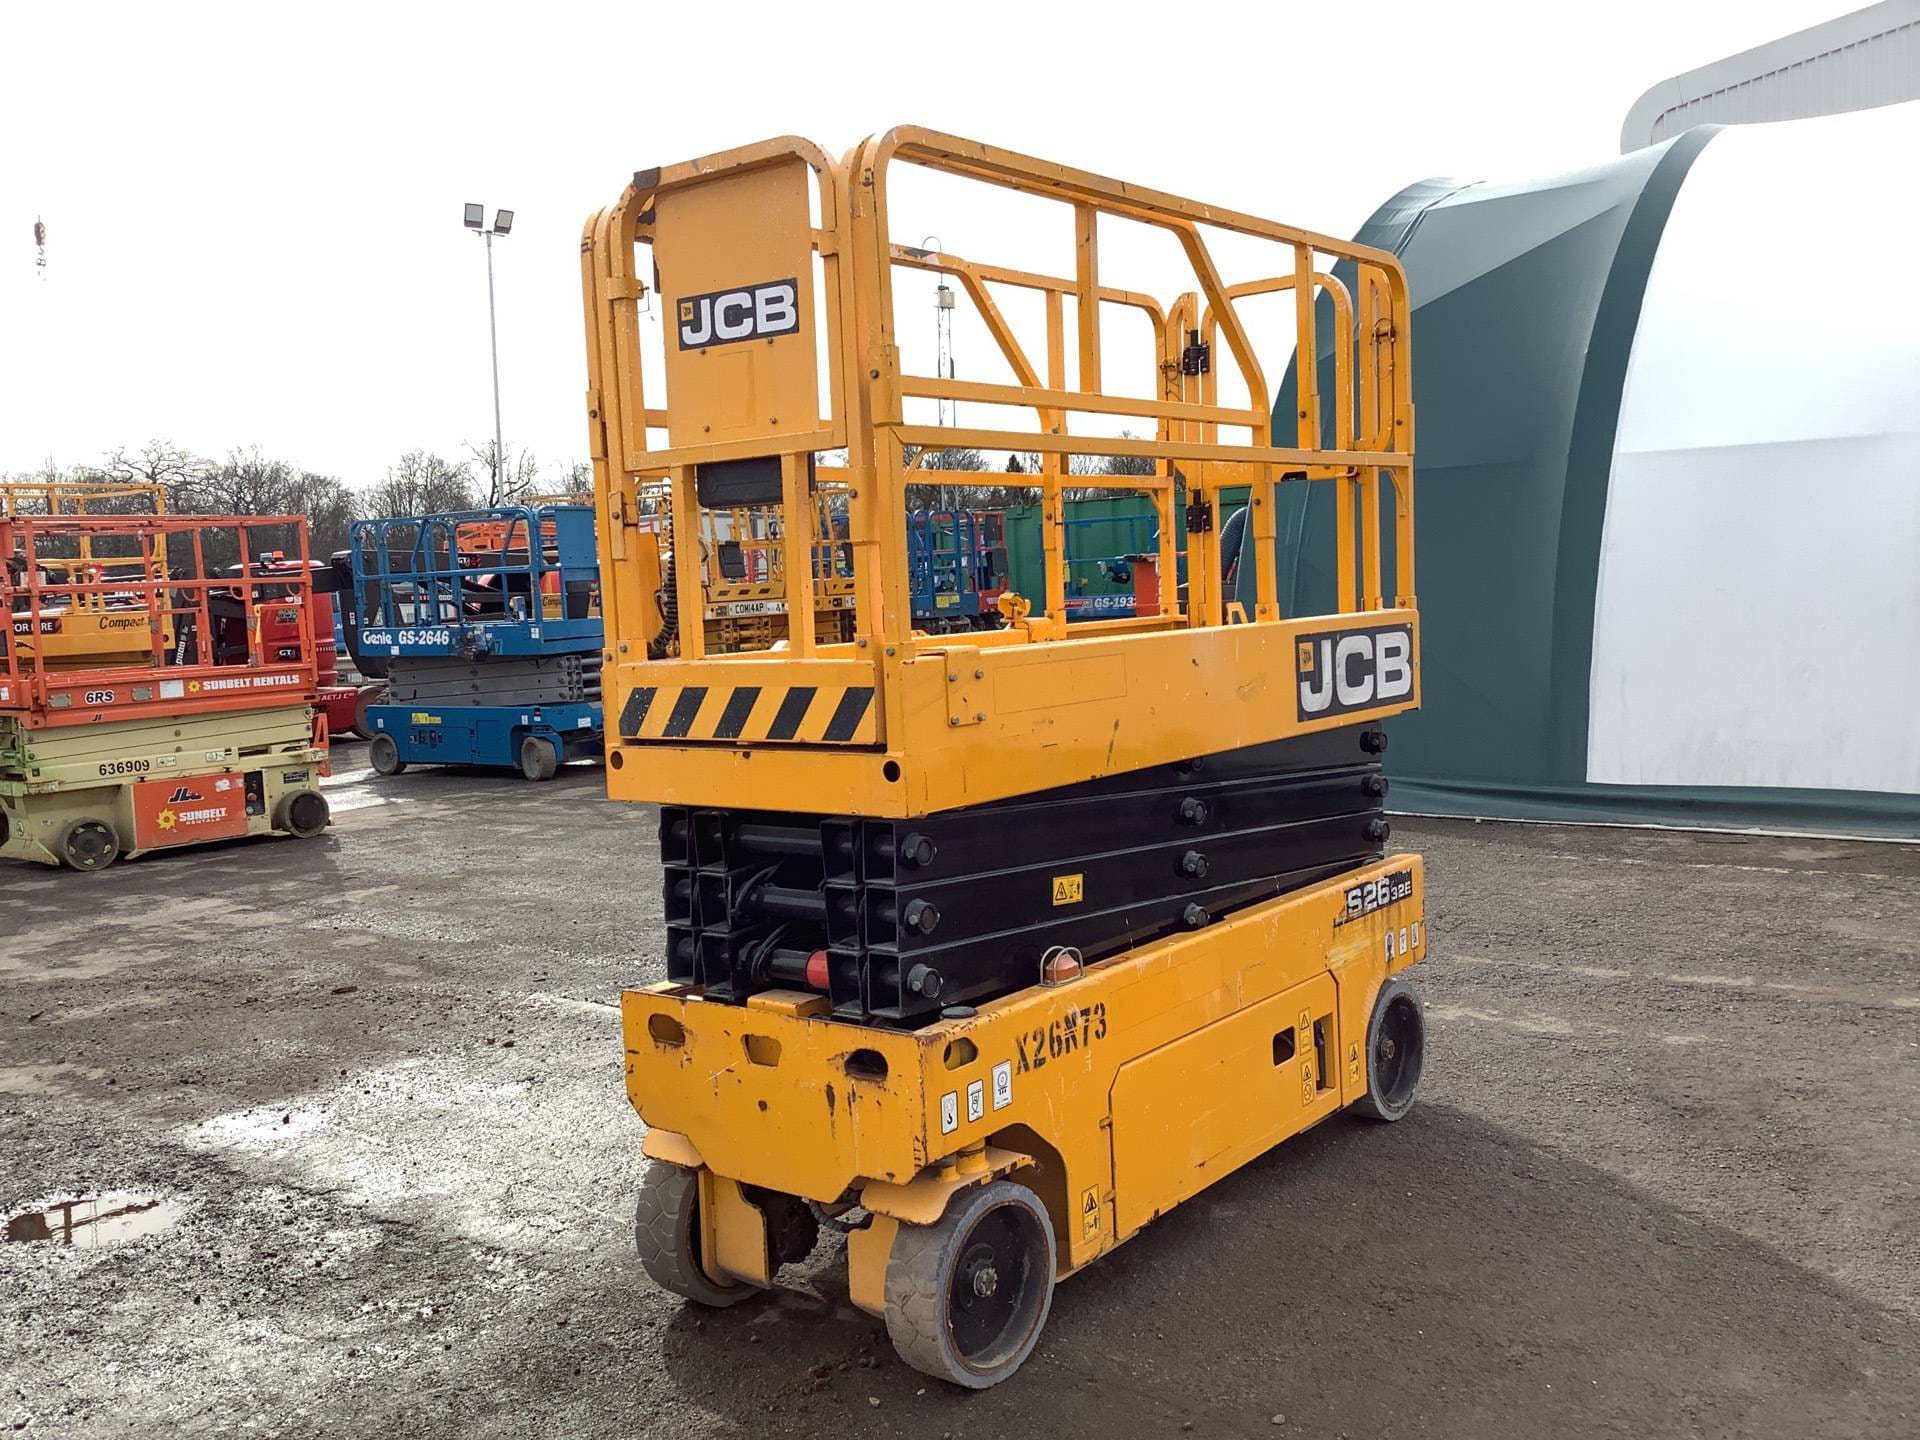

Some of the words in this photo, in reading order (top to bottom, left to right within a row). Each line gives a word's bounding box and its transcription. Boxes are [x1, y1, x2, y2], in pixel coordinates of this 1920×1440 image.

[681, 284, 797, 345] JCB
[12, 623, 29, 632] OR
[99, 616, 144, 630] Compact
[362, 631, 392, 645] Genie
[398, 630, 449, 645] GS-2646
[1300, 631, 1412, 712] JCB
[203, 678, 251, 690] SUNBELT
[253, 675, 300, 687] RENTALS
[85, 691, 114, 704] 6RS
[99, 759, 150, 776] 636909
[179, 807, 227, 822] SUNBELT
[1016, 1002, 1107, 1075] X26N73
